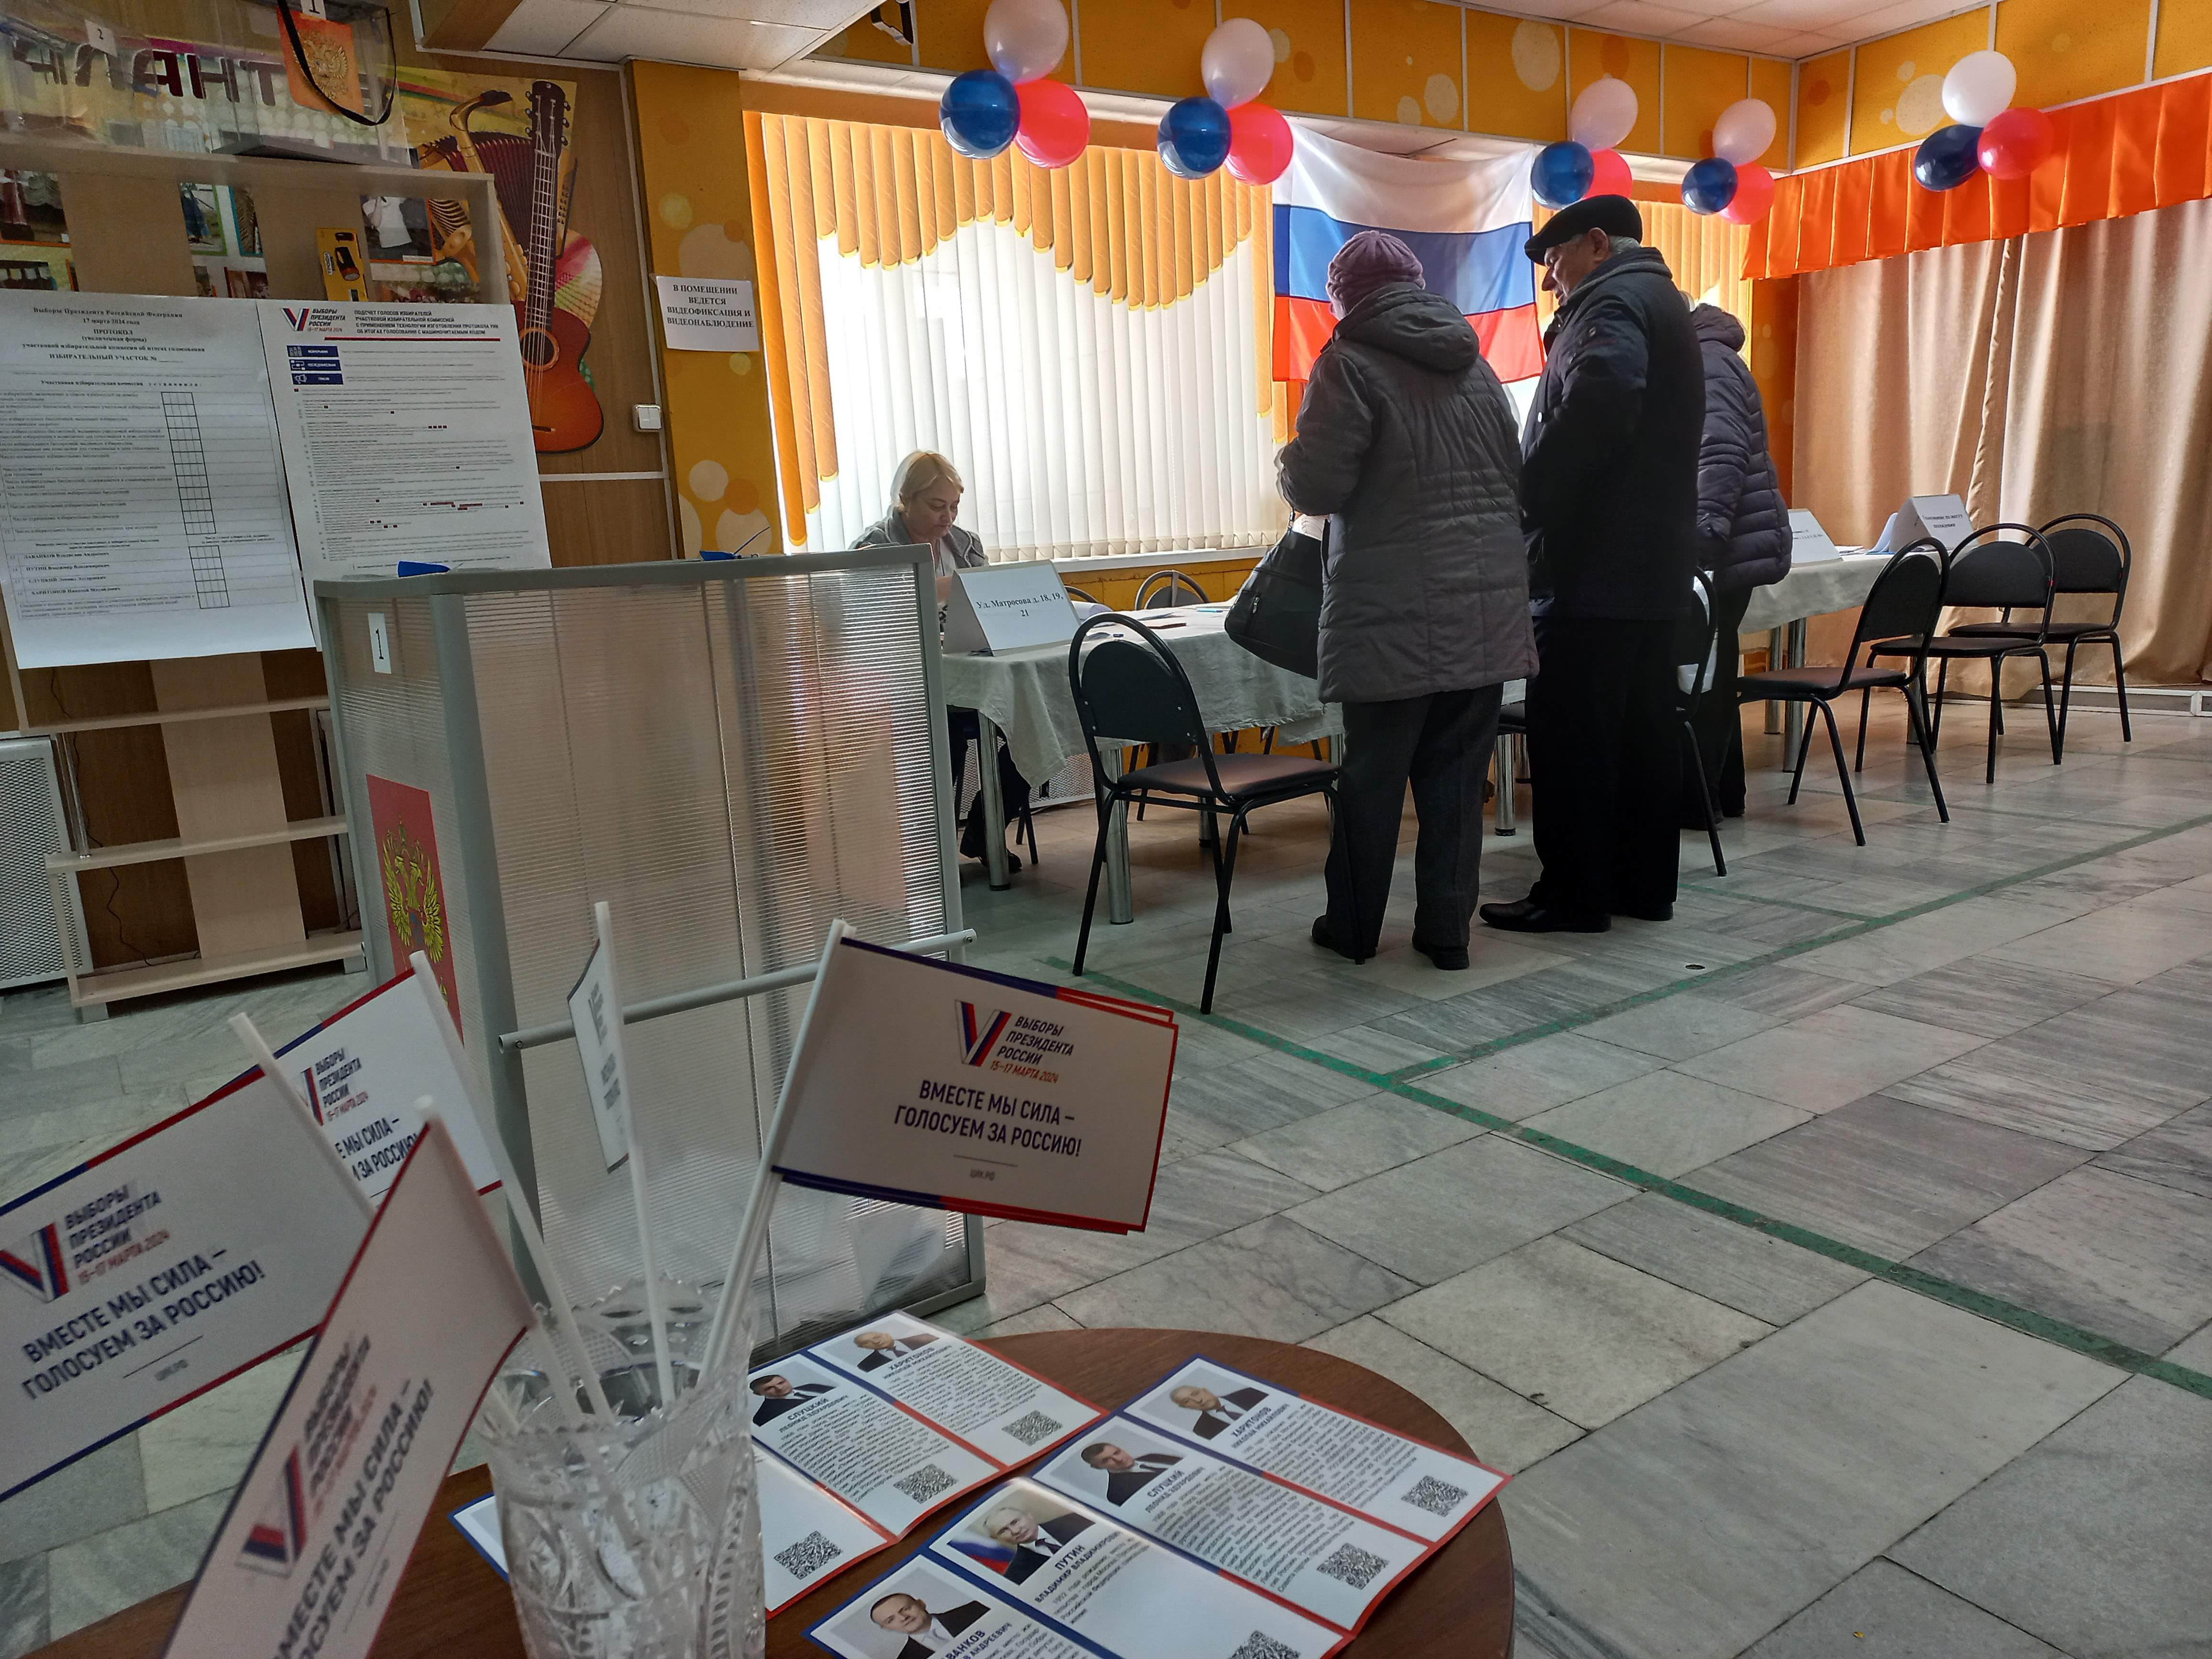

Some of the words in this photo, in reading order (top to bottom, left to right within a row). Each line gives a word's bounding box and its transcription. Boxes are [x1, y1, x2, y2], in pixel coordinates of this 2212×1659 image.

[98, 28, 104, 40] 2
[681, 285, 738, 294] ПОМЕЩЕНИИ
[688, 297, 726, 305] ВЕДЕТСЯ
[667, 306, 742, 317] ВИДЕОФИКСАЦИЯ
[667, 317, 754, 328] ВИДЕОНАБЛЮДЕНИЕ
[992, 598, 1031, 609] Матросова
[1040, 594, 1051, 602] 18,
[1052, 592, 1064, 600] 19,
[376, 629, 384, 660] 1
[1015, 1016, 1064, 1037] ВЫБОРЫ
[996, 1045, 1043, 1065] РОССИИ
[1006, 1030, 1074, 1056] ПРЕЗИДЕНТА
[314, 1047, 346, 1075] ВЫБОРЫ
[319, 1057, 362, 1091] ПРЕЗИДЕНТА
[1012, 1065, 1040, 1080] МАРТА
[1039, 1071, 1059, 1083] 2024
[322, 1083, 351, 1108] РОССИИ
[919, 1079, 985, 1110] ВМЕСТЕ
[987, 1093, 1018, 1117] МЫ
[1020, 1100, 1060, 1125] СИЛА
[342, 1132, 362, 1156] МЫ
[362, 1117, 394, 1146] СИЛА
[894, 1105, 985, 1139] ГОЛОСУЕМ
[987, 1122, 1006, 1143] ЗА
[1011, 1126, 1082, 1157] РОССИЮ!
[358, 1158, 375, 1179] ЗА
[970, 1169, 995, 1181] ЦИК.РФ
[64, 1184, 131, 1230] ВЫБОРЫ
[68, 1191, 162, 1249] ПРЕЗИДЕНТА
[73, 1227, 132, 1270] РОССИИ
[21, 1306, 111, 1364] ВМЕСТЕ
[106, 1282, 153, 1319] МЫ
[149, 1254, 213, 1297] СИЛА
[21, 1327, 137, 1400] ГОЛОСУЕМ
[133, 1313, 168, 1341] ЗА
[163, 1259, 266, 1326] РОССИЮ!
[787, 1398, 830, 1421] СЛУЦКИЙ
[352, 1515, 377, 1559] ЗА
[373, 1377, 434, 1513] РОССИЮ!
[1147, 1470, 1185, 1497] СЛУЦКИЙ
[274, 1540, 338, 1659] МЕСТЕ
[334, 1479, 367, 1546] МЫ
[362, 1401, 402, 1482] СИЛА
[1054, 1544, 1086, 1571] ПУТИН
[1034, 1569, 1072, 1604] ВЛАДИМИР
[940, 1629, 986, 1659] ВАНКОВ
[967, 1622, 1013, 1658] АНДРЕЕВИЧ
